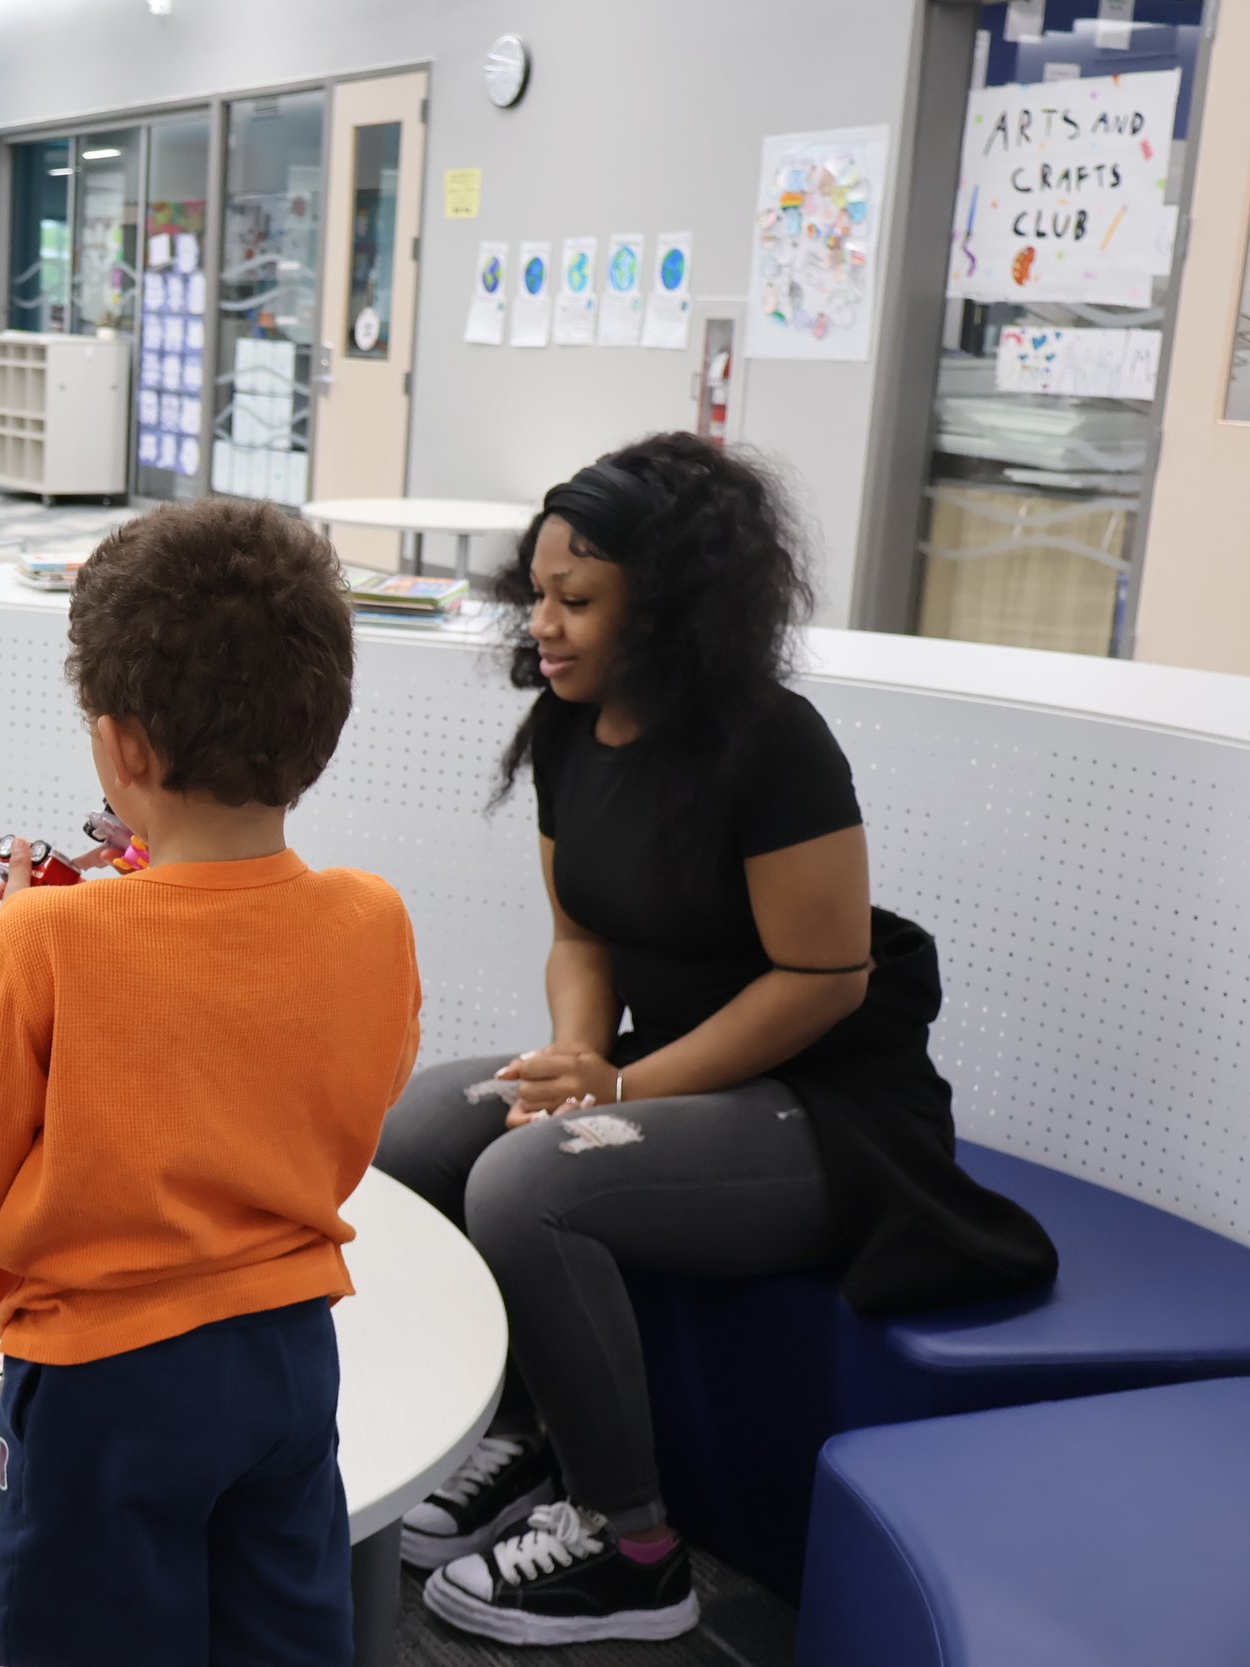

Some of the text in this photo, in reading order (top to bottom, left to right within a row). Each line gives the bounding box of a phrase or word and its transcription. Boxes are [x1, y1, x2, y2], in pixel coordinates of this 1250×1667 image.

[983, 109, 1145, 157] ARTS AND
[1011, 163, 1122, 193] CRAFTS
[1012, 208, 1089, 241] CLUB
